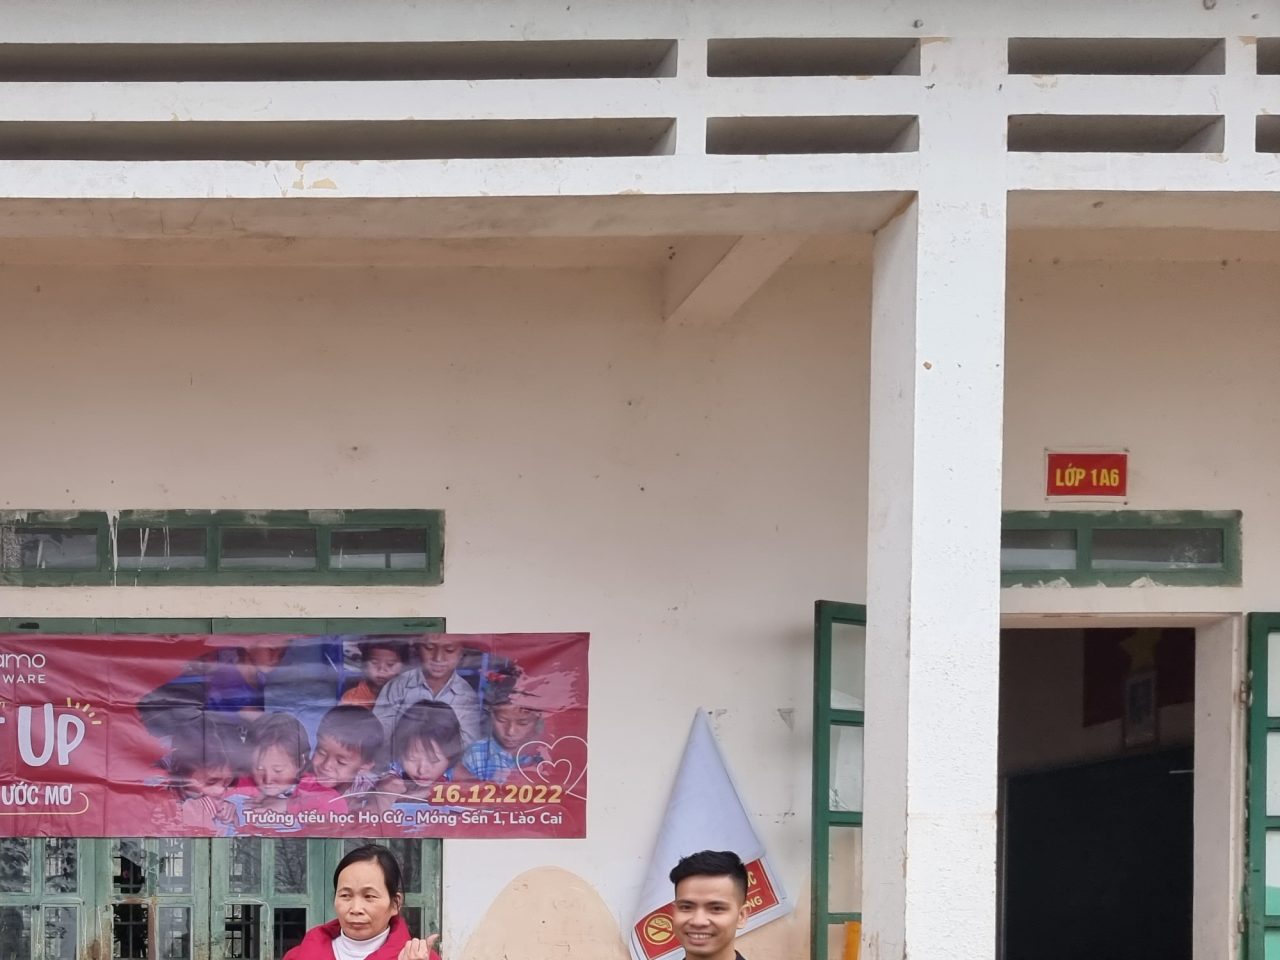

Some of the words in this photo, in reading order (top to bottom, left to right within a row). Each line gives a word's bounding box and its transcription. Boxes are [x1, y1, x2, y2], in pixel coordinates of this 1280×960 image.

[1056, 463, 1086, 486] LỚP
[1091, 468, 1120, 486] 1A6
[17, 703, 86, 767] UP
[1, 782, 39, 806] ƯỚC
[44, 783, 73, 806] MƠ
[431, 784, 563, 803] 16.12.2022
[243, 809, 294, 826] Trường
[298, 808, 325, 824] tiểu
[330, 811, 354, 826] học
[383, 810, 403, 824] Cứ
[416, 811, 456, 826] Móng
[462, 809, 488, 824] Sến
[492, 812, 506, 826] 1,
[510, 811, 536, 824] Lào
[540, 812, 562, 824] Cai
